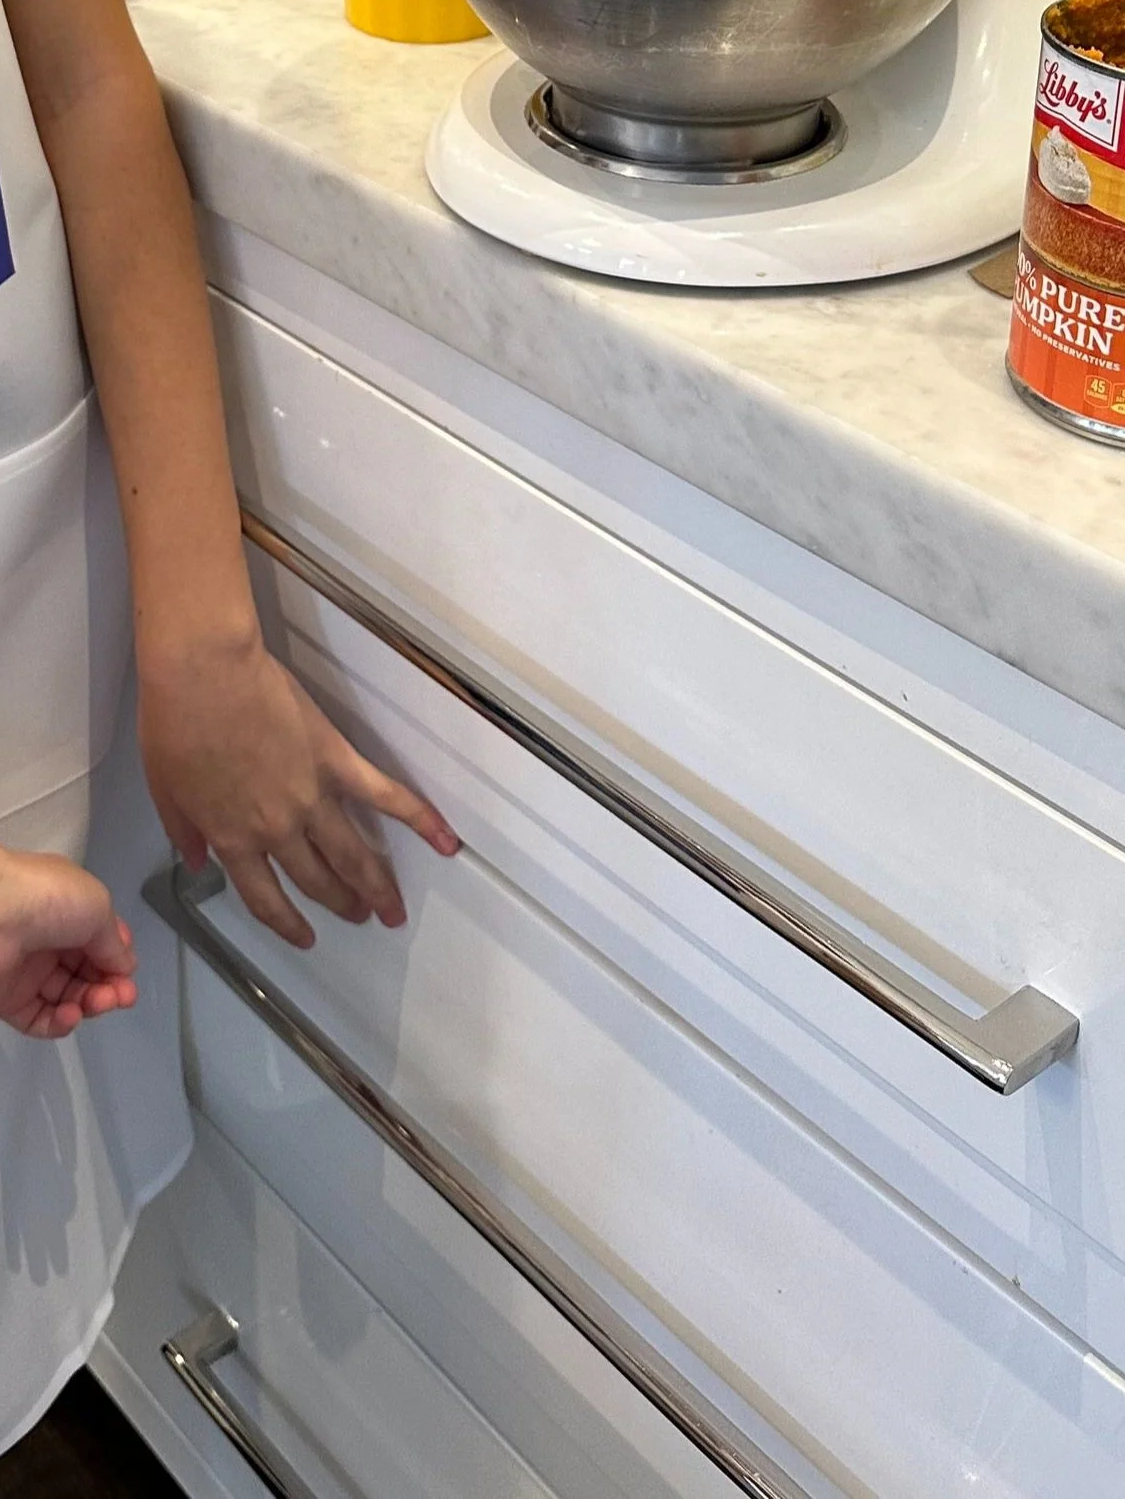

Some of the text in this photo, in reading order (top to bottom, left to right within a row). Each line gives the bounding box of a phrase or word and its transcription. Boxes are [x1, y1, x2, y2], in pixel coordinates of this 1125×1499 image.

[1039, 58, 1107, 123] Libby's
[1014, 275, 1114, 356] UMPKIN
[1040, 274, 1125, 331] PURE
[1042, 333, 1121, 372] PRESERVATIVES
[1090, 378, 1106, 394] 45
